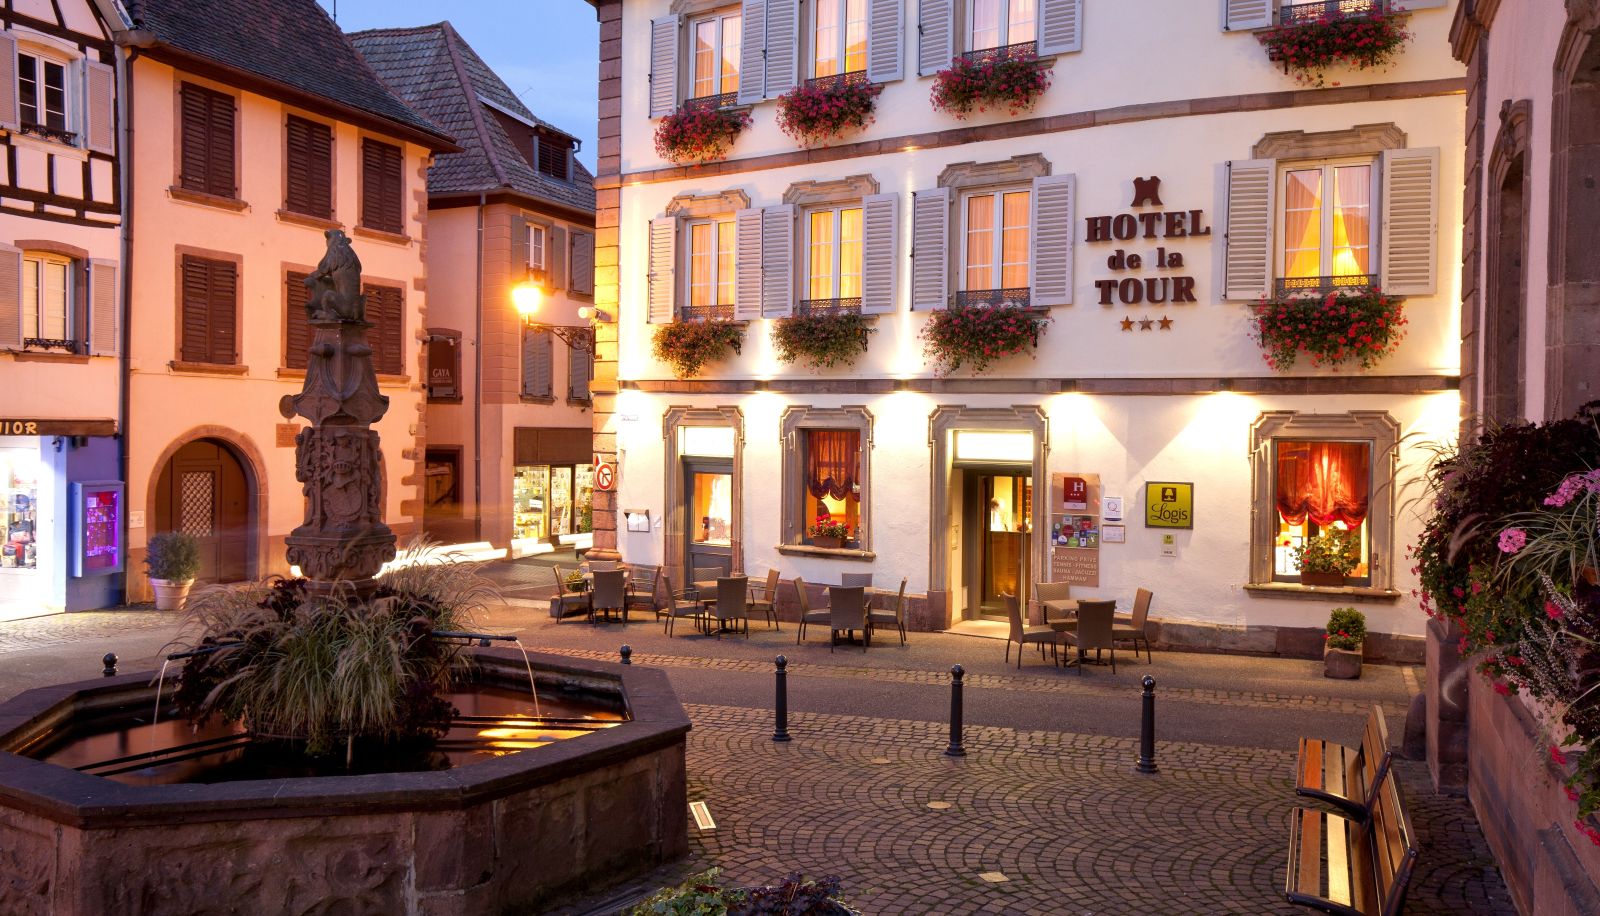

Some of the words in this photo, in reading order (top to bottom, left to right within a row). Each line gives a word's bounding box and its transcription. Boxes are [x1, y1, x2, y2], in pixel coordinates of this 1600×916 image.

[1084, 209, 1211, 242] HOTEL
[1107, 249, 1141, 270] de
[1156, 247, 1184, 268] la
[1094, 276, 1198, 305] TOUR
[432, 368, 450, 377] GAYA
[1073, 481, 1084, 492] H
[1151, 503, 1188, 523] Logis
